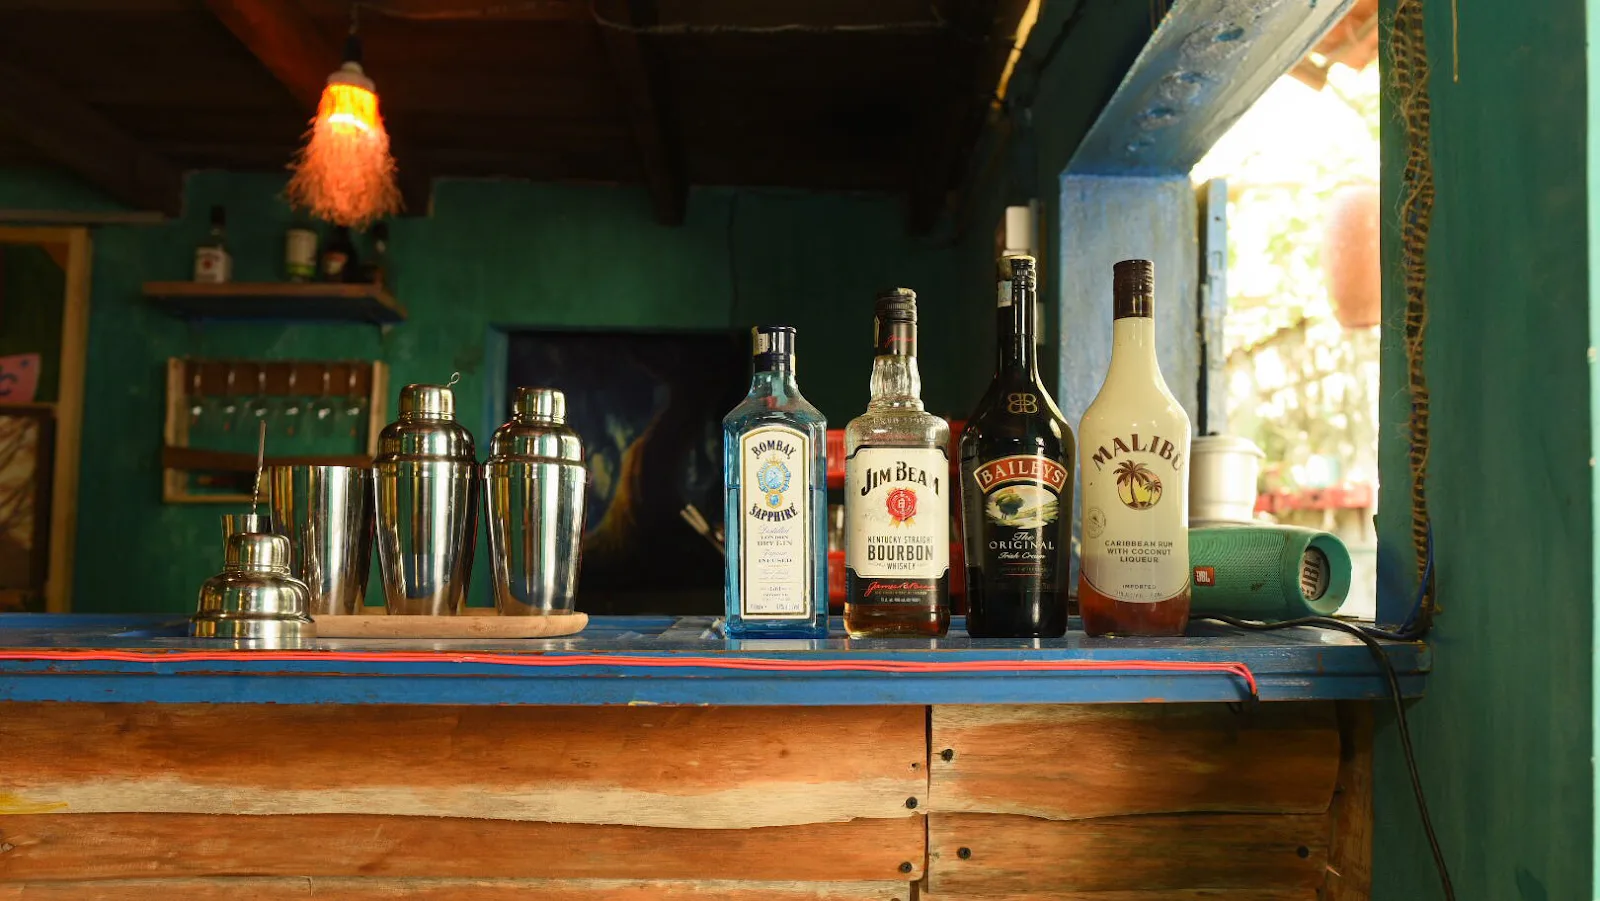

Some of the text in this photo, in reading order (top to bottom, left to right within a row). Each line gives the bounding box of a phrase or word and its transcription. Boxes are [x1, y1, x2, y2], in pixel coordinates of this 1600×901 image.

[751, 440, 796, 459] BOMBAY
[1092, 434, 1183, 472] MALIBU
[981, 460, 1064, 485] BAILEYS
[861, 468, 891, 496] JIM
[749, 502, 799, 522] SAPPHIRE
[867, 536, 933, 544] KENTUCKY STRAIGHT
[1012, 531, 1035, 541] The
[989, 540, 1055, 550] ORIGINAL
[868, 544, 934, 561] BOURBON
[998, 551, 1020, 559] Irish
[1131, 548, 1172, 556] COCONUT
[887, 562, 916, 570] WHISKEY
[1195, 570, 1211, 583] JBL
